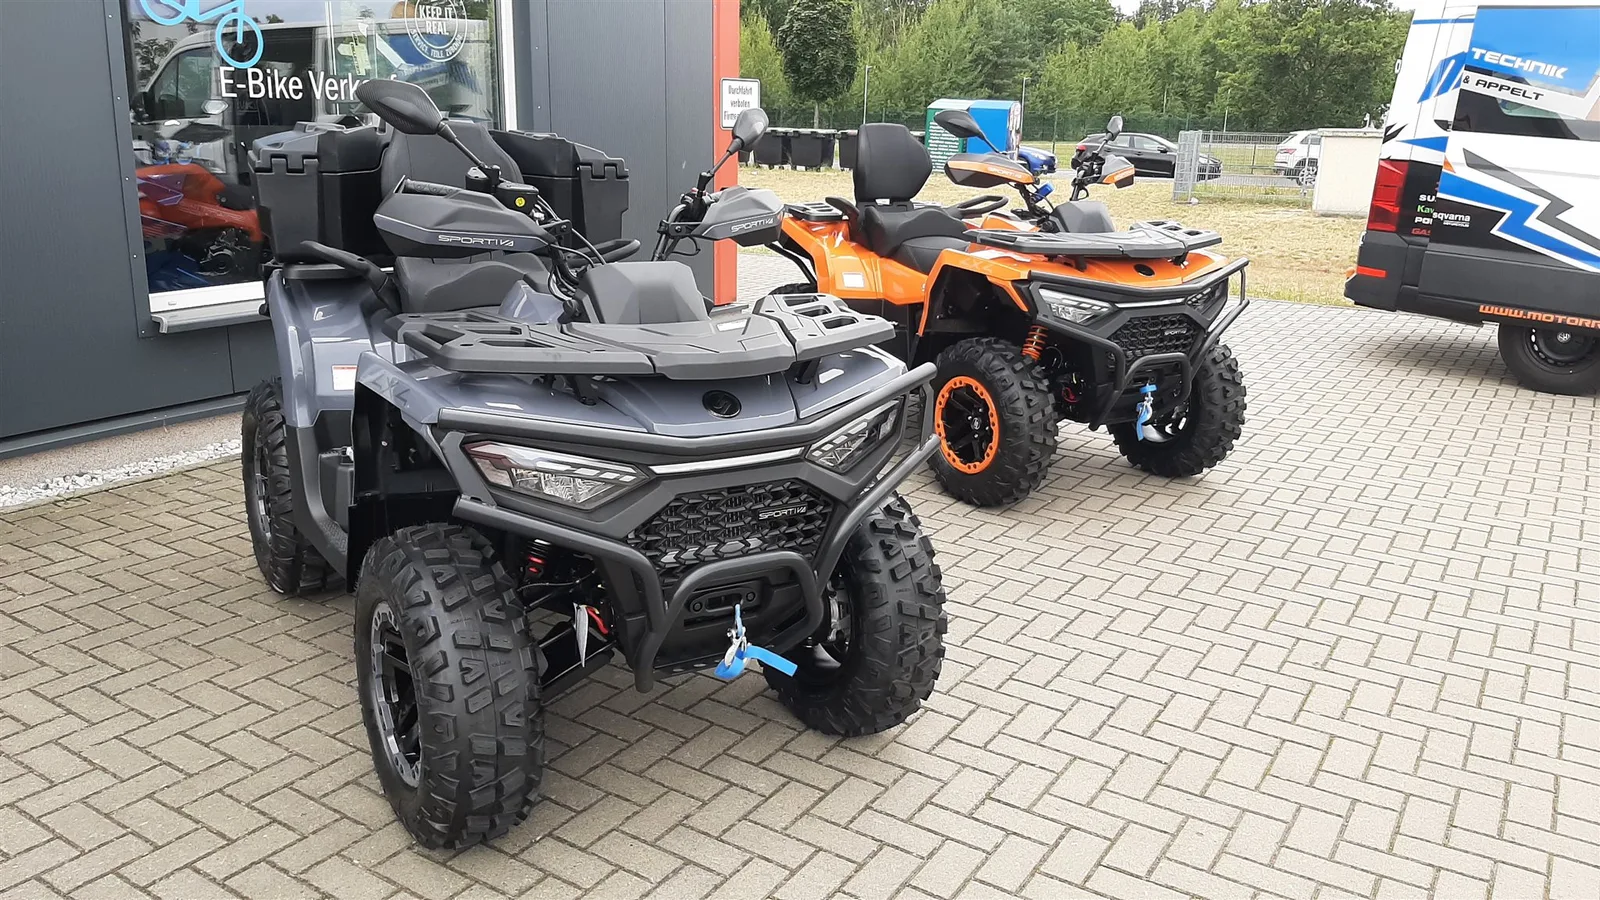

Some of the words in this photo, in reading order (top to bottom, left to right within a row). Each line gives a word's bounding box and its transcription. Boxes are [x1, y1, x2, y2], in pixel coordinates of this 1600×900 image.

[419, 5, 442, 19] KEEP
[444, 7, 453, 19] IT
[426, 21, 449, 35] REAL
[1472, 47, 1568, 79] TECHNIK
[219, 66, 303, 100] E-Bike
[307, 70, 398, 101] Verk
[728, 85, 753, 95] Durchfahrt
[1462, 75, 1470, 84] &
[1475, 79, 1544, 101] APPELT
[730, 98, 751, 108] verboten
[1432, 211, 1471, 222] sqvarna
[731, 217, 774, 233] SPORTIVA
[438, 234, 514, 247] SPORTIVA
[758, 506, 807, 520] SPORTIVA
